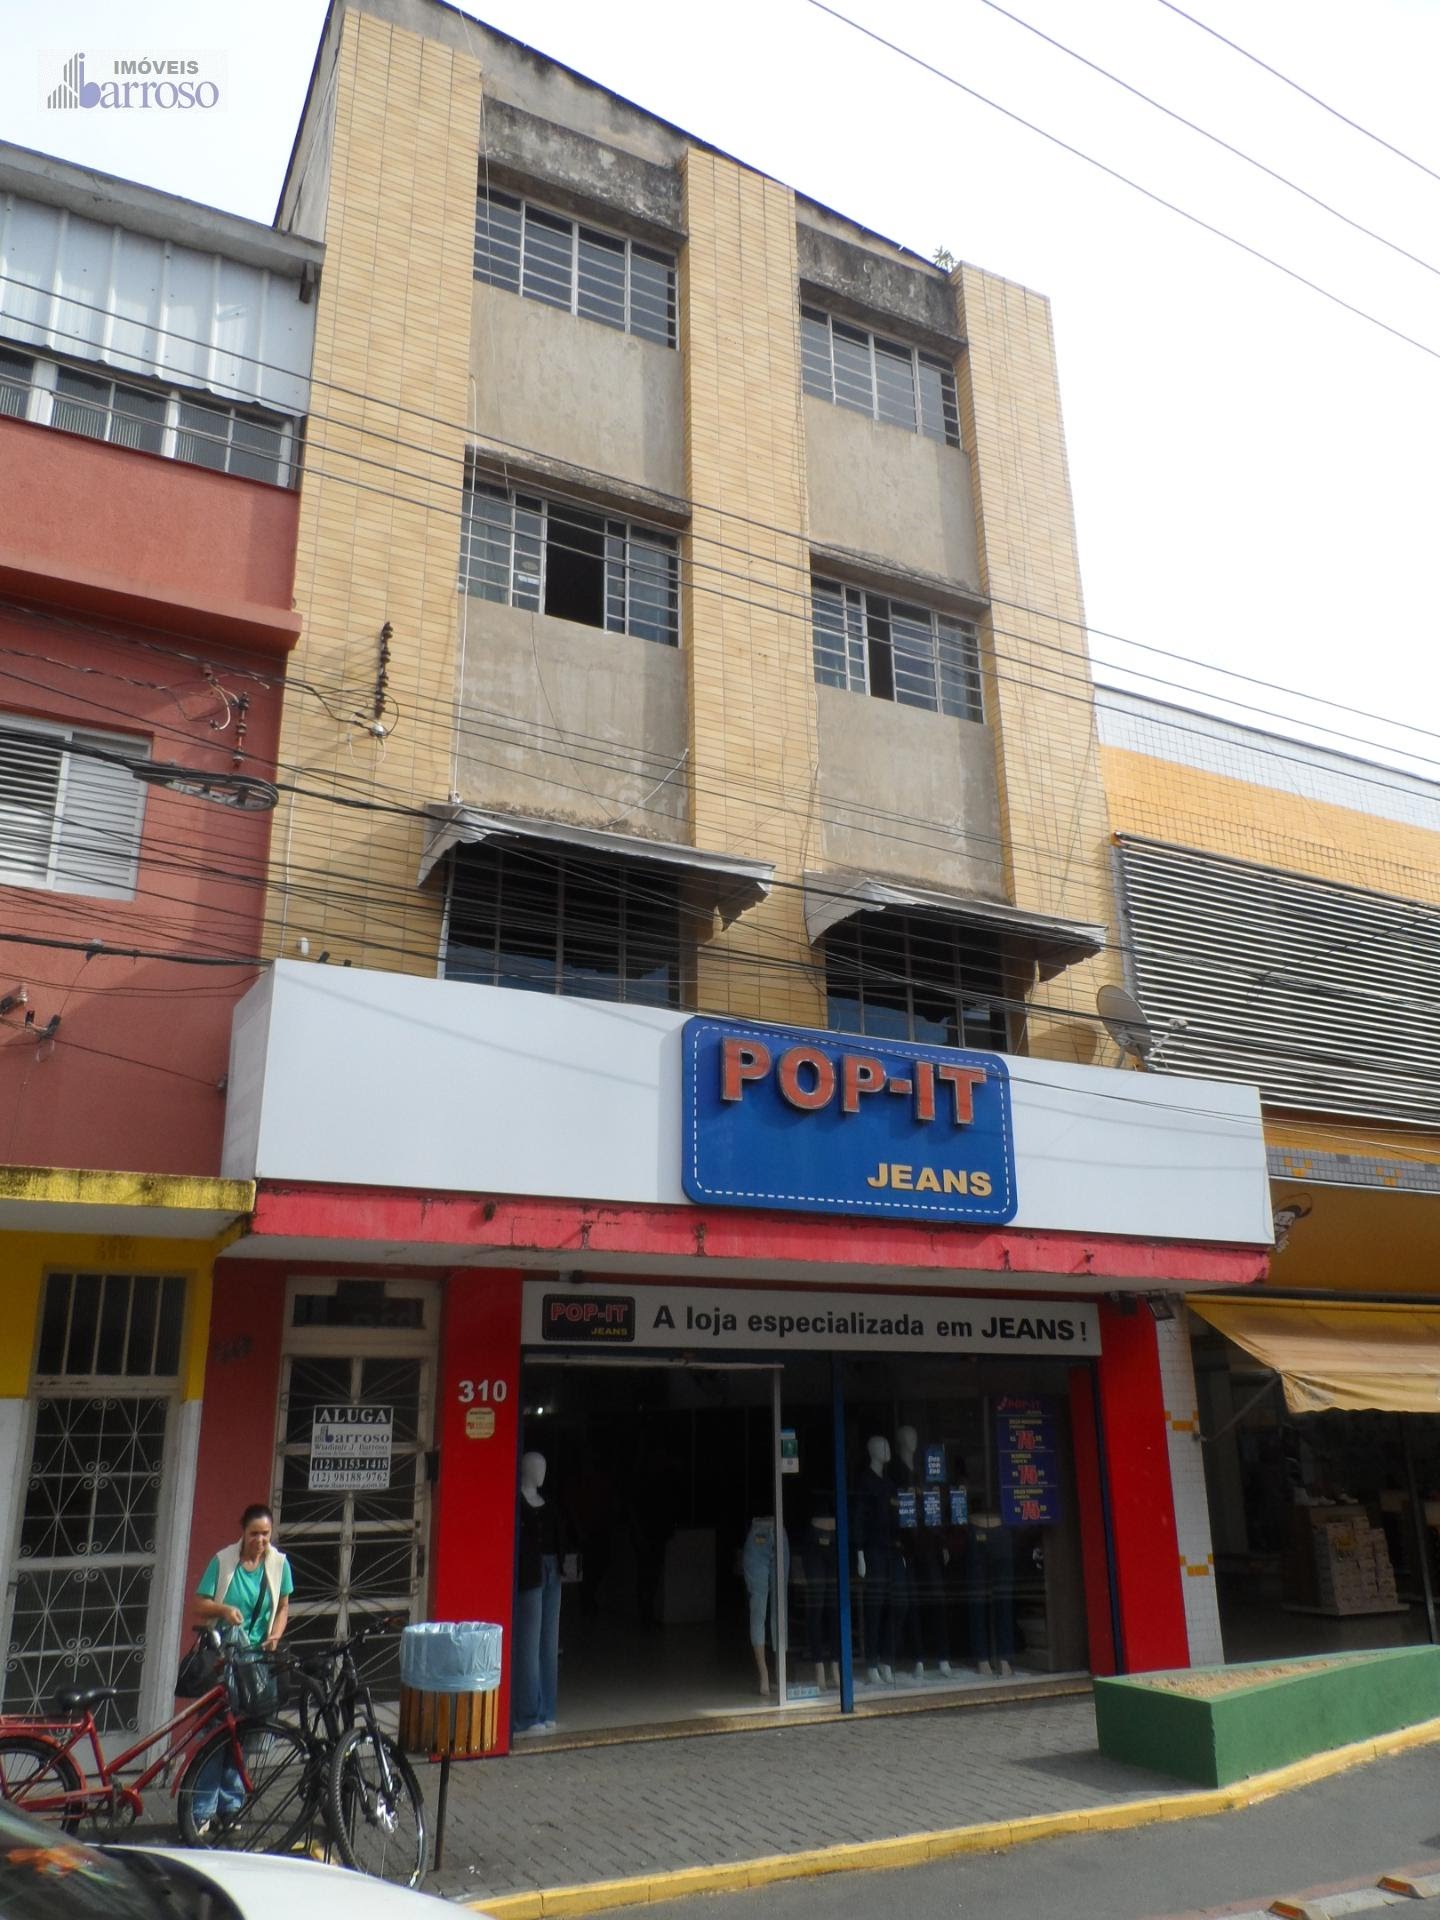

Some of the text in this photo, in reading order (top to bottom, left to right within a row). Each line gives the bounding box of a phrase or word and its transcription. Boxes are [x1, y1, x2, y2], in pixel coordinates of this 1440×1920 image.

[720, 1036, 987, 1126] POP-IT
[867, 1162, 992, 1197] JEANS
[550, 1302, 629, 1322] POP-IT
[652, 1305, 676, 1329] A
[686, 1306, 737, 1336] loja
[747, 1311, 924, 1337] especializada
[936, 1320, 972, 1337] em
[591, 1327, 628, 1336] JEANS
[458, 1379, 507, 1403] 310
[319, 1408, 388, 1423] ALUGA
[325, 1425, 390, 1443] barroso
[314, 1458, 389, 1471] (12) 3153-1418
[312, 1472, 331, 1483] (12)
